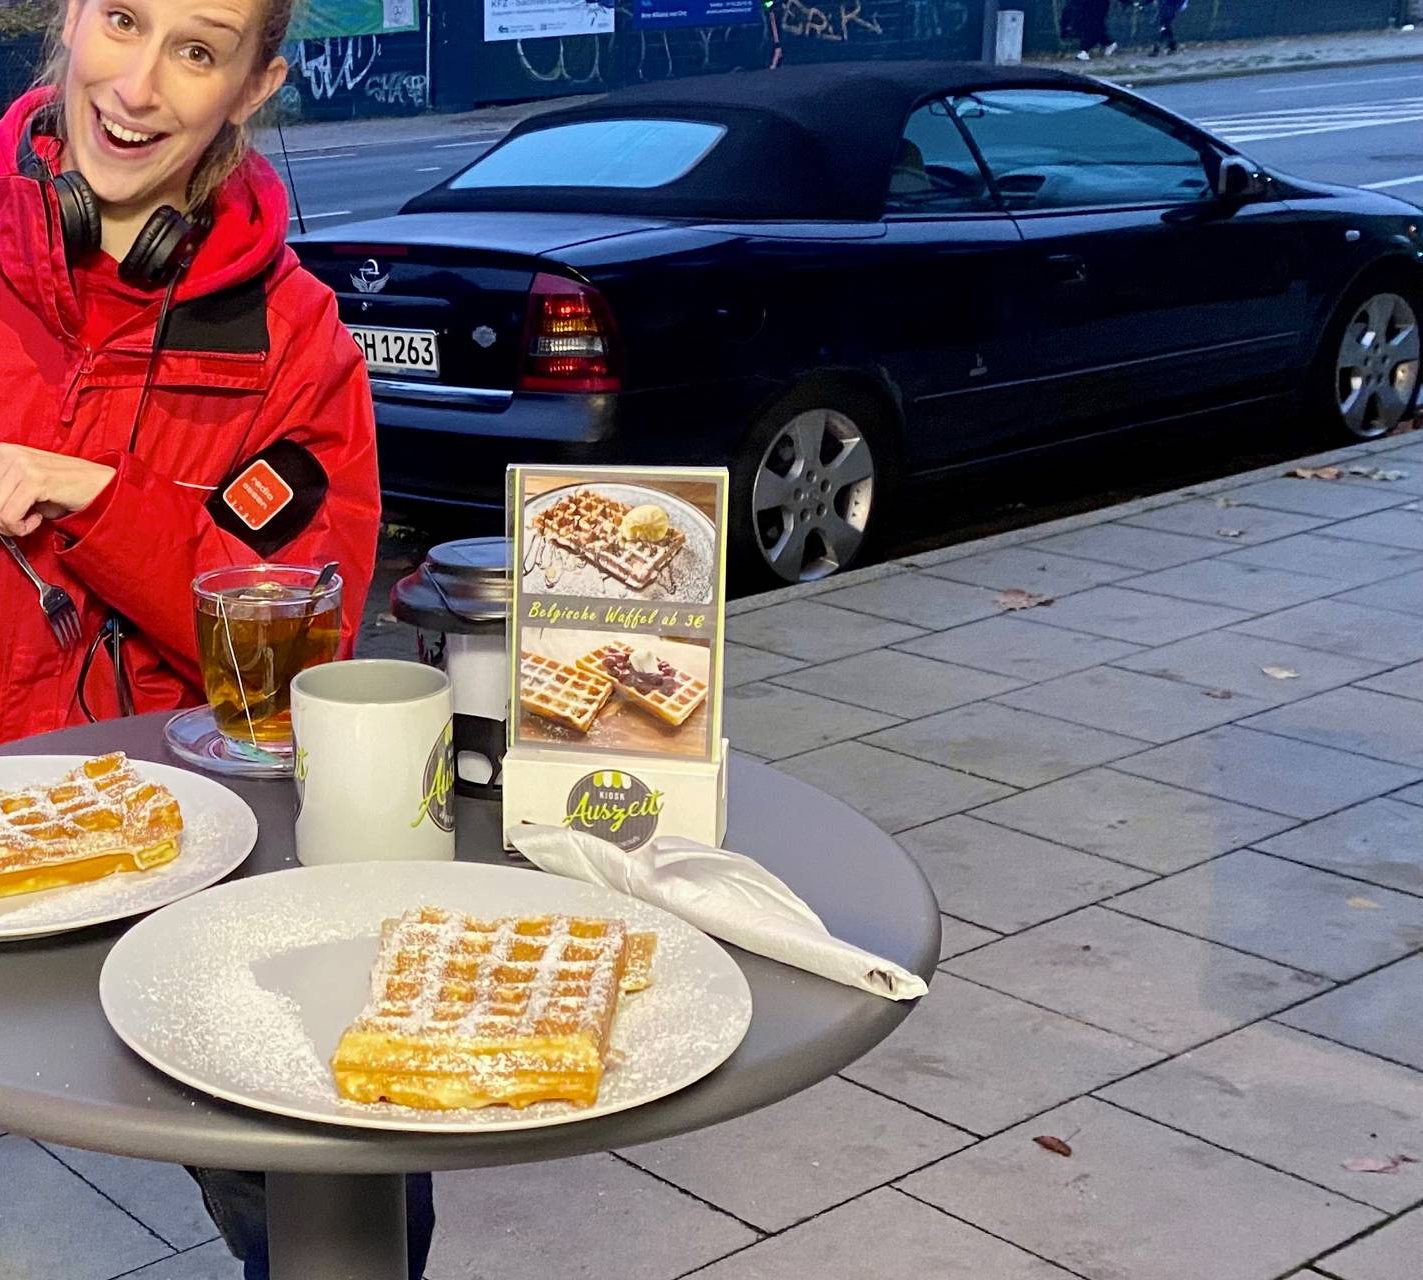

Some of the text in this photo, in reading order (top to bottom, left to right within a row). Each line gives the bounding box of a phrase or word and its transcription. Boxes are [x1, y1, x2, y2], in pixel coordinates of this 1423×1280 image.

[381, 335, 434, 366] 1263
[242, 482, 268, 510] essen
[251, 477, 274, 501] radio
[528, 601, 706, 629] Belgische Waffel ab 3€
[599, 791, 626, 800] KIOSK
[562, 789, 665, 833] Auszeit
